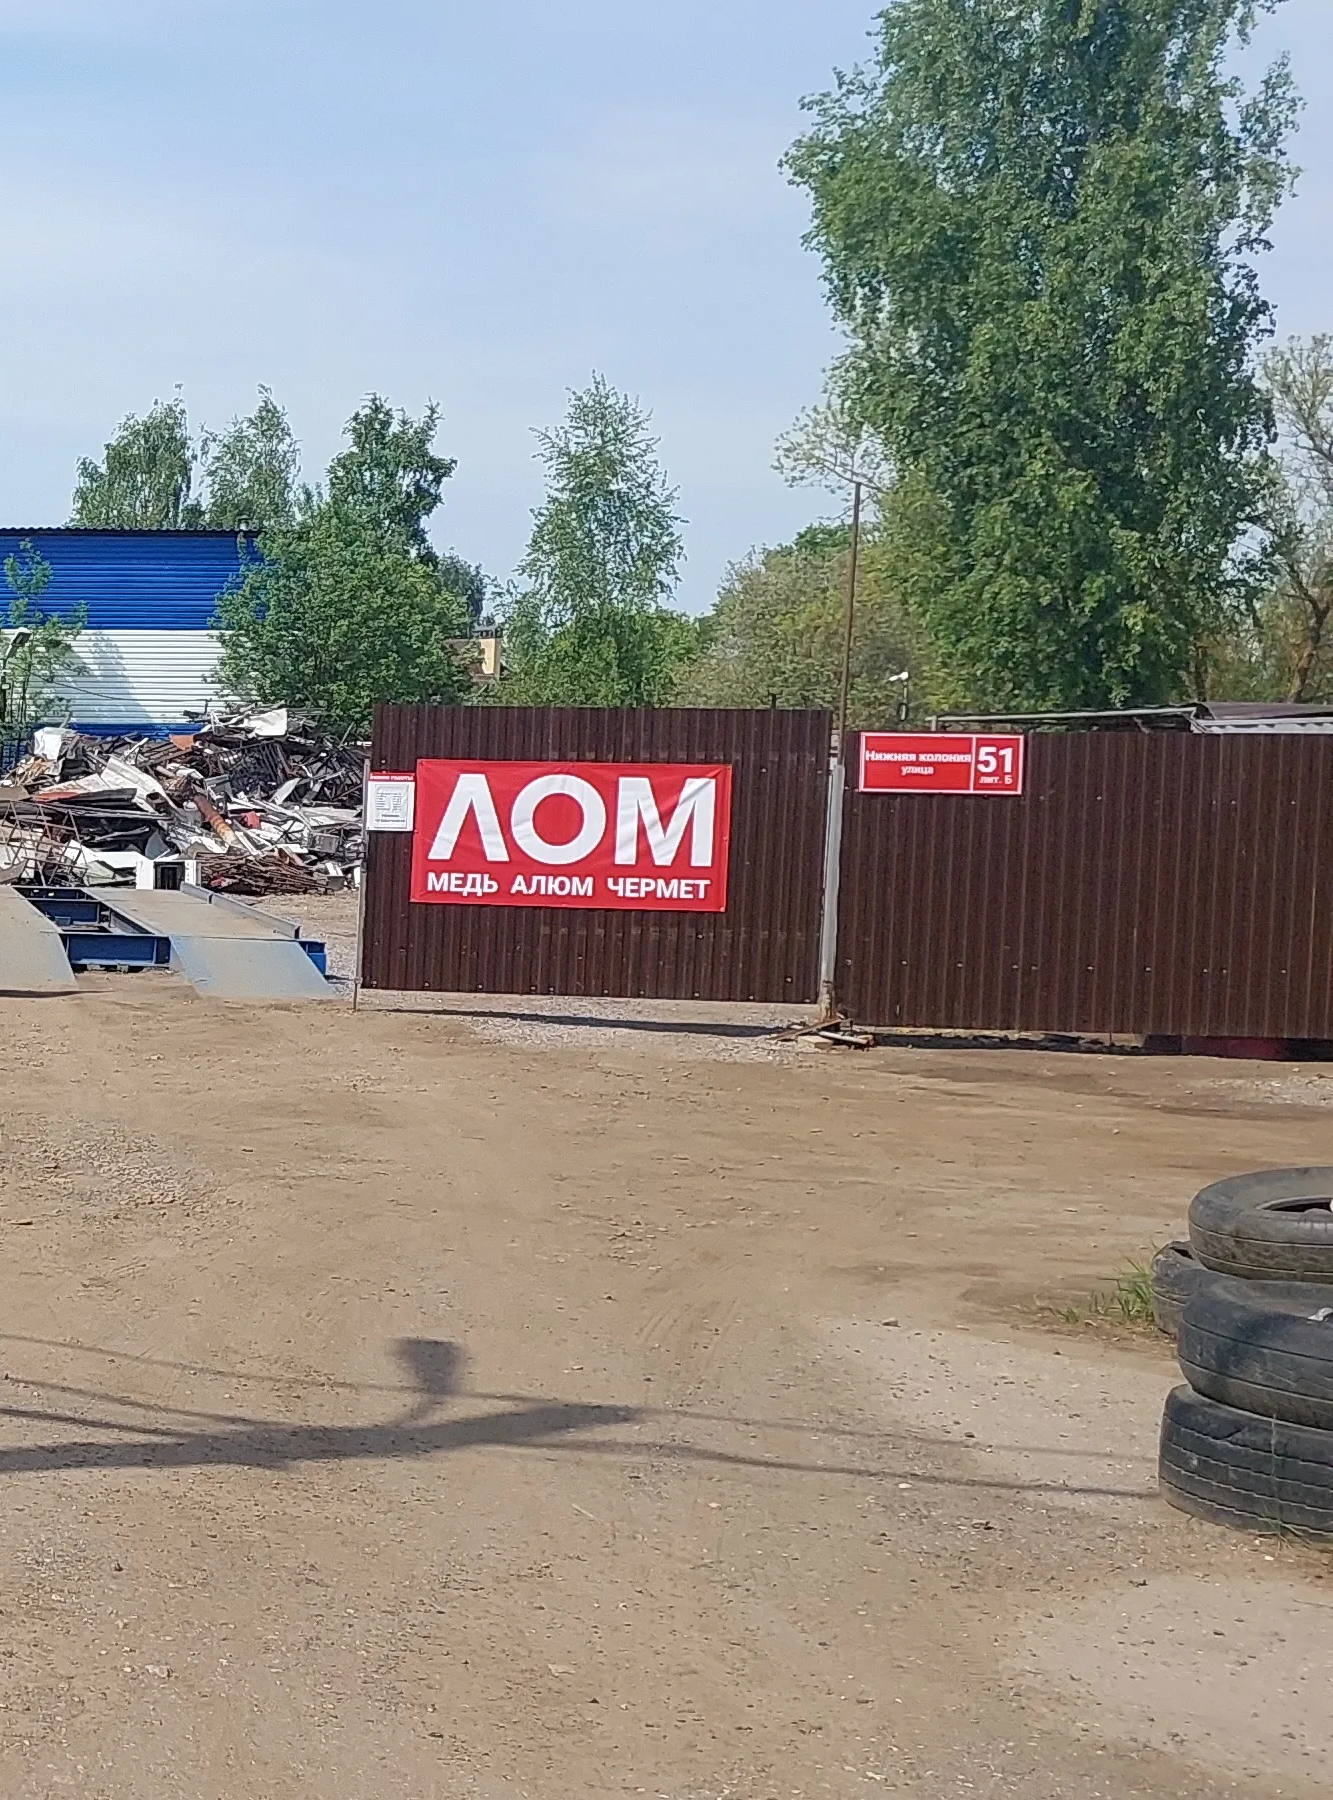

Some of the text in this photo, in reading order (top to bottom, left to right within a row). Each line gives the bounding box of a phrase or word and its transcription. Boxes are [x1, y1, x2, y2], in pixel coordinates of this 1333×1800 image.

[865, 750, 972, 763] Нижняя колония
[977, 746, 1013, 773] 51
[901, 765, 934, 776] улица
[428, 773, 716, 867] ЛОМ
[427, 872, 711, 899] МЕДЬ АЛЮМ ЧЕРМЕТ
